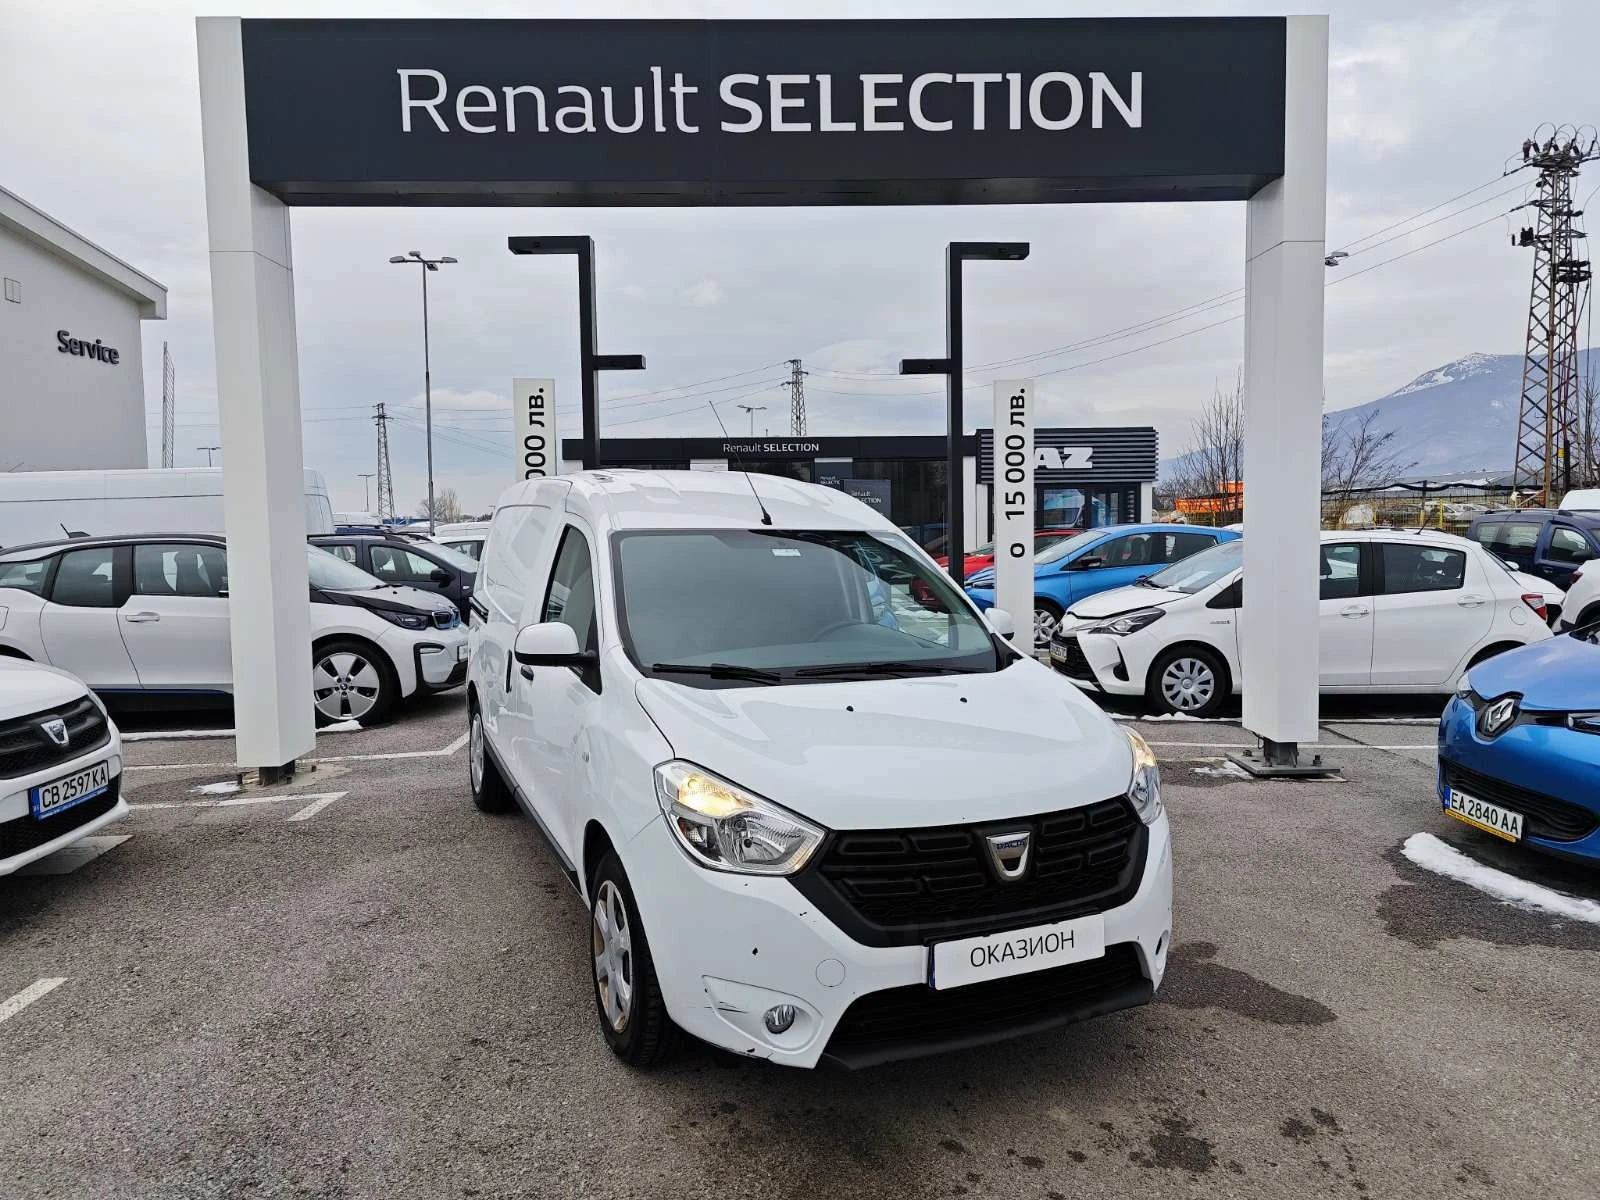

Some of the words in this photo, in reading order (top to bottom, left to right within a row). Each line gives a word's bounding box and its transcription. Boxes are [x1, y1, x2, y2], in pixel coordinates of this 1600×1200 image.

[397, 66, 700, 134] Renault
[719, 71, 1143, 133] SELECTION
[57, 329, 120, 365] Service
[528, 387, 544, 427] лв.
[1010, 388, 1025, 427] лв.
[723, 442, 761, 453] Renault
[763, 443, 819, 452] SELECTION
[1005, 434, 1025, 483] 000
[1005, 491, 1025, 520] 15
[42, 785, 60, 808] CB
[62, 773, 91, 801] 2597
[92, 766, 107, 788] KA
[1451, 791, 1466, 813] EA
[1467, 799, 1498, 826] 2840
[1501, 813, 1519, 835] AA
[970, 929, 1074, 967] ОКАЗИОН
